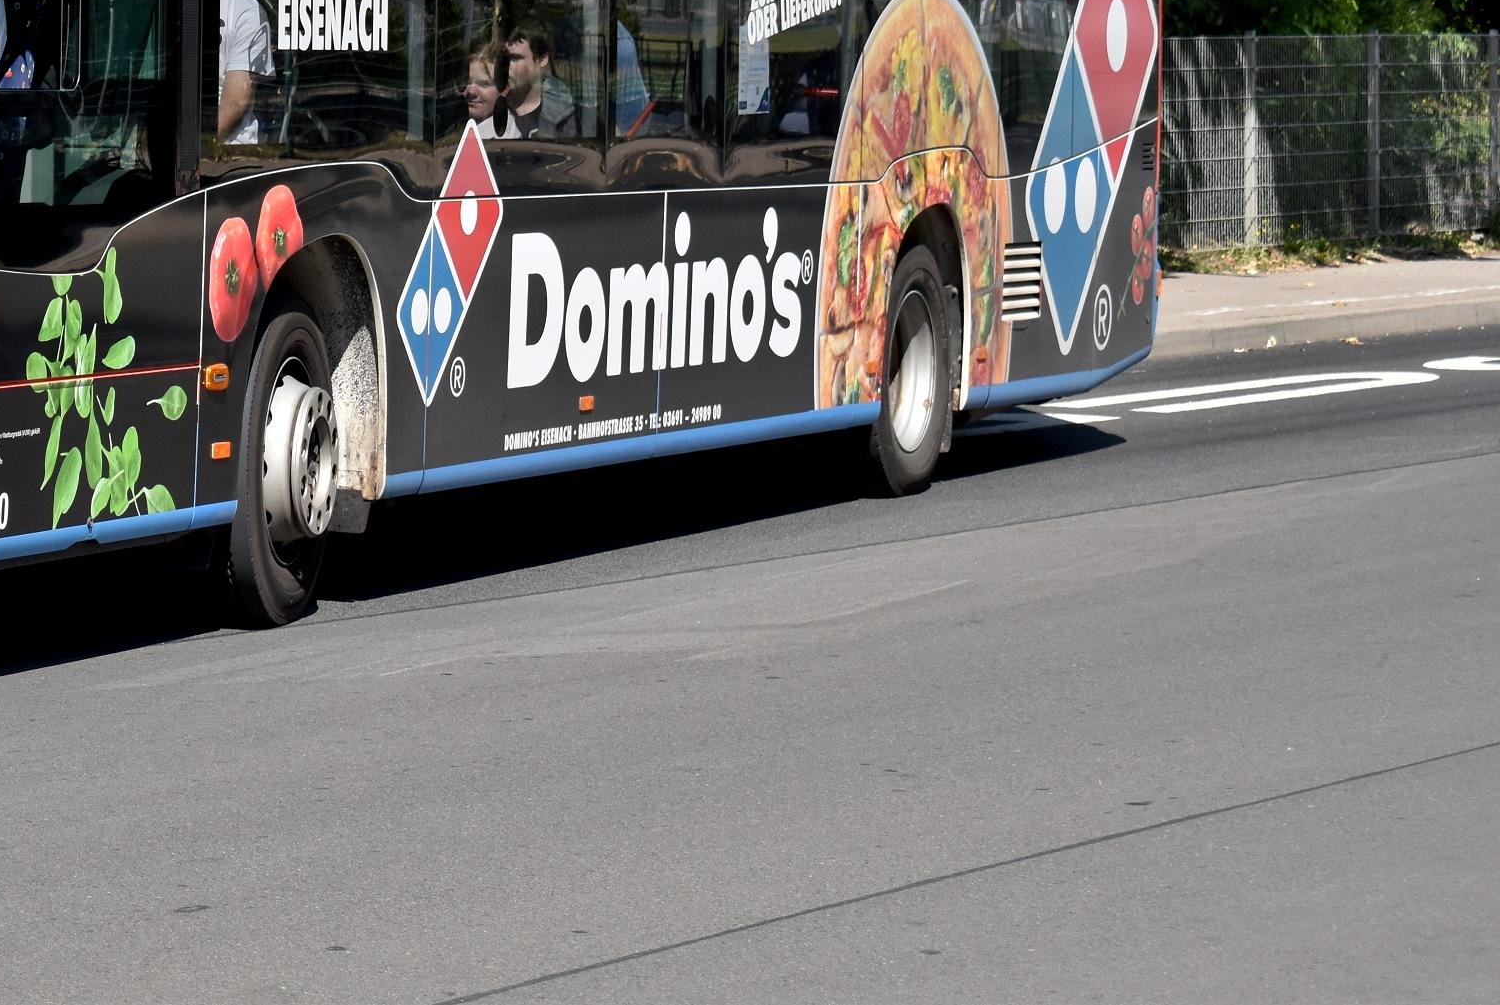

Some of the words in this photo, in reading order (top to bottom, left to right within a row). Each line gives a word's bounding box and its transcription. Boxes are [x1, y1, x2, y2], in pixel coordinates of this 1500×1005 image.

[747, 3, 779, 46] ODER
[507, 206, 801, 390] Domino's
[540, 425, 572, 446] EISENACH
[577, 416, 633, 440] BAHNHOFSTRASSE
[634, 414, 644, 432] 35
